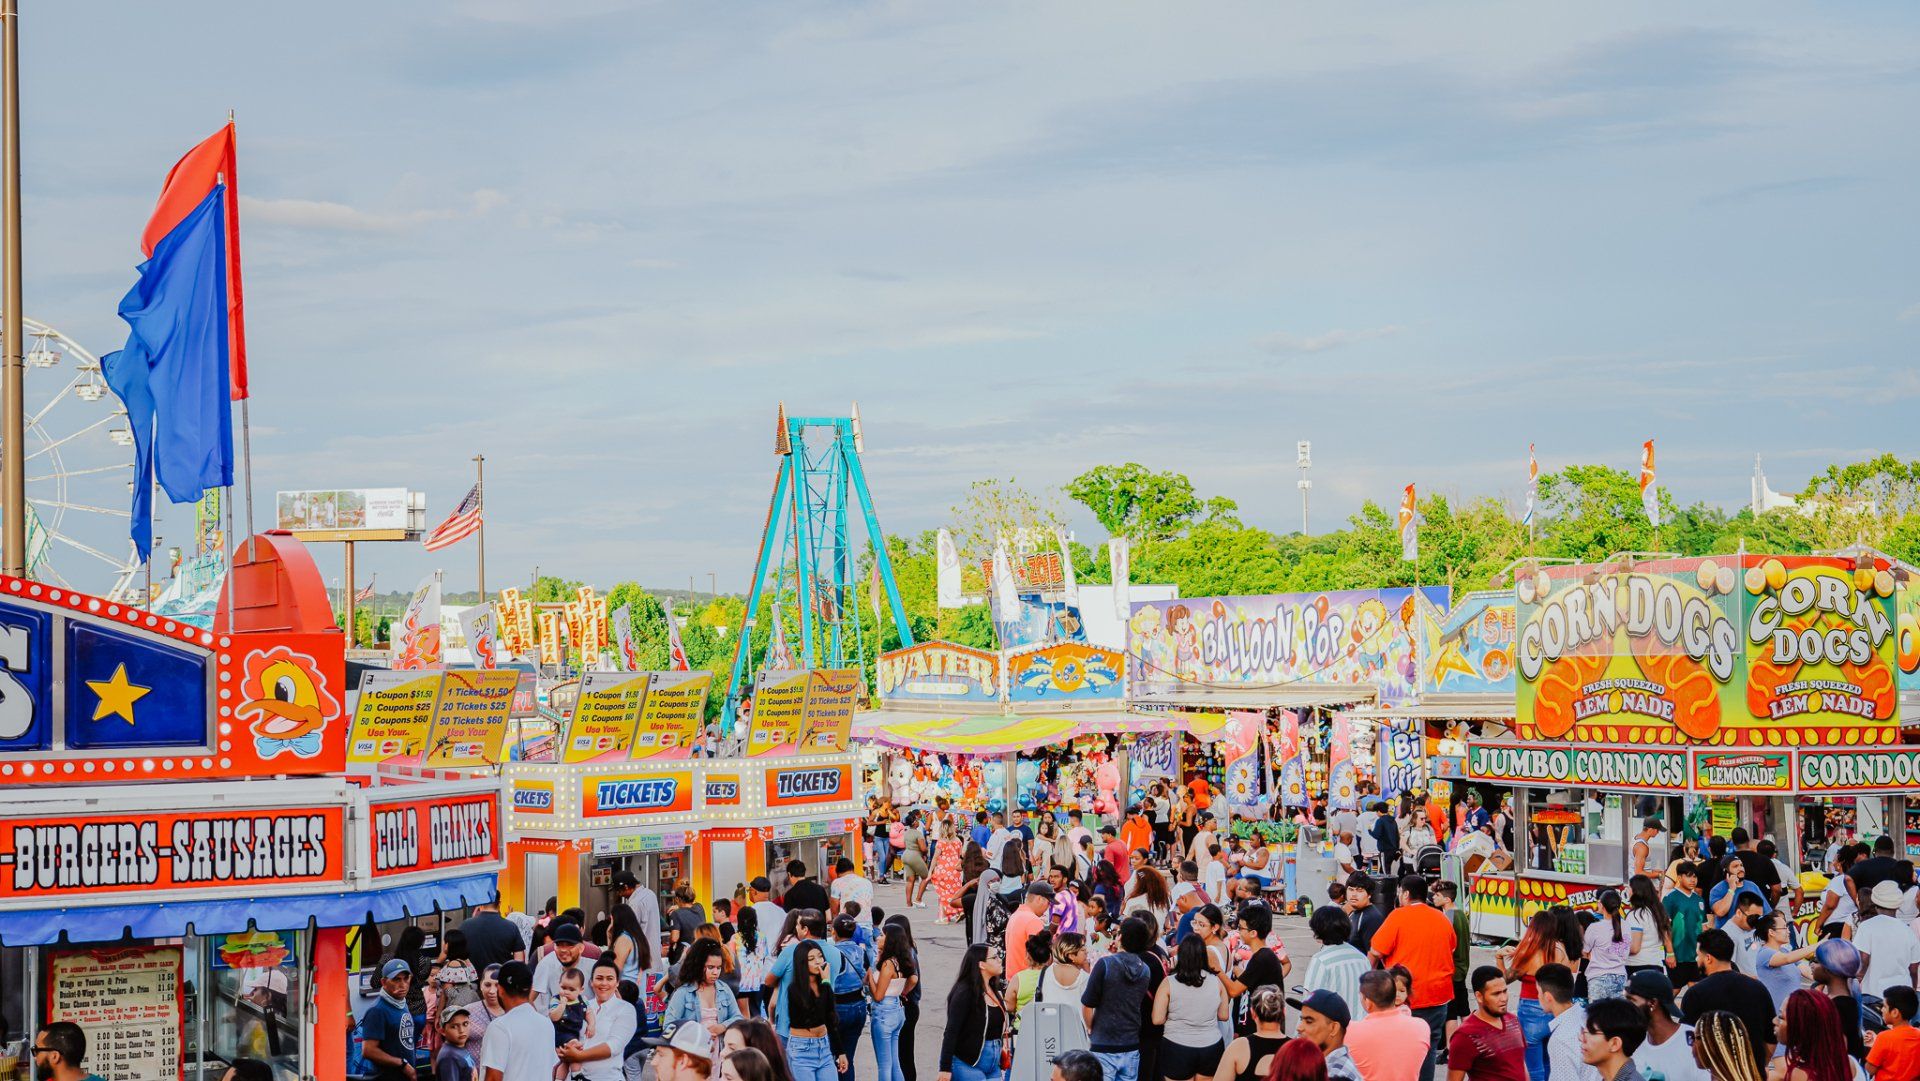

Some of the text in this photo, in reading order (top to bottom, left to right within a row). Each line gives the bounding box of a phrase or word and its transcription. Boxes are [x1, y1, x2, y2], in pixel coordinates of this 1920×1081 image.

[1749, 574, 1893, 648] CORN
[1520, 574, 1736, 683] CORN DOGS
[1202, 603, 1344, 675] BALLOON POP
[1773, 628, 1871, 665] DOGS
[881, 650, 996, 697] WATER
[376, 690, 412, 700] Coupon
[455, 688, 482, 696] Ticket
[485, 688, 508, 696] $1.50
[1582, 678, 1665, 695] FRESH SQUEEZED
[1775, 679, 1862, 696] FRESH SQUEEZED
[593, 692, 621, 700] Coupon
[377, 704, 413, 713] Coupons
[443, 703, 453, 711] 20
[457, 702, 487, 710] Tickets
[594, 703, 625, 711] Coupons
[659, 701, 688, 709] Coupons
[1574, 689, 1674, 722] LEMONADE
[1770, 690, 1876, 720] LEMONADE
[374, 717, 411, 725] Coupons
[413, 715, 428, 723] $60
[453, 717, 484, 725] Tickets
[487, 716, 502, 724] $60
[592, 715, 622, 723] Coupons
[447, 728, 488, 736] Use Your
[1473, 748, 1684, 786] JUMBO CORNDOGS
[778, 769, 841, 793] TICKETS
[1709, 766, 1776, 786] LEMONADE
[598, 779, 676, 806] TICKETS
[375, 801, 492, 870] COLD DRINKS
[108, 987, 126, 995] Tenders
